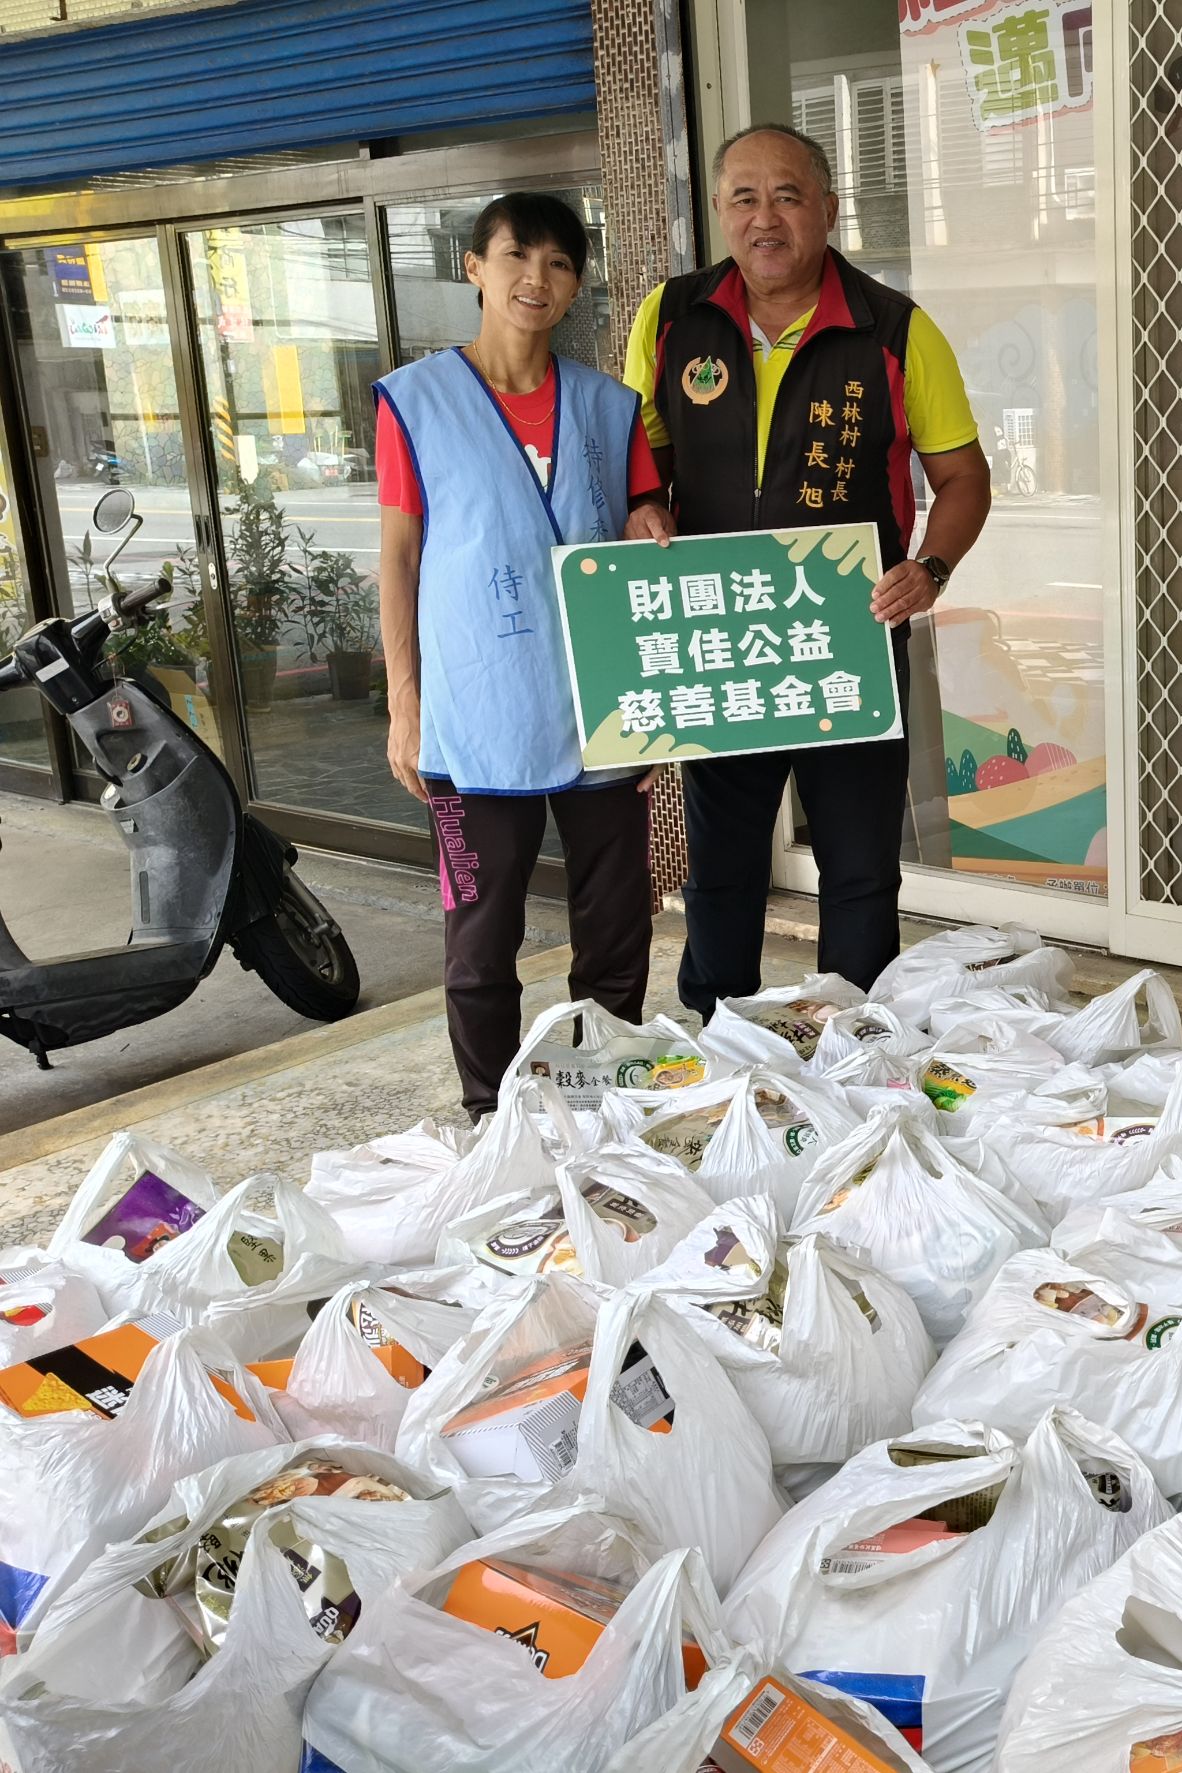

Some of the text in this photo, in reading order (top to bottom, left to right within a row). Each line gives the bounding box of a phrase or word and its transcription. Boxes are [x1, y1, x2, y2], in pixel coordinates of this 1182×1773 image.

[796, 400, 836, 508] 陳長旭
[626, 564, 827, 623] 財團法人
[634, 618, 834, 678] 寶佳公益
[617, 670, 862, 734] 慈善基金會
[431, 795, 481, 903] Hualien
[85, 1385, 134, 1414] 迷
